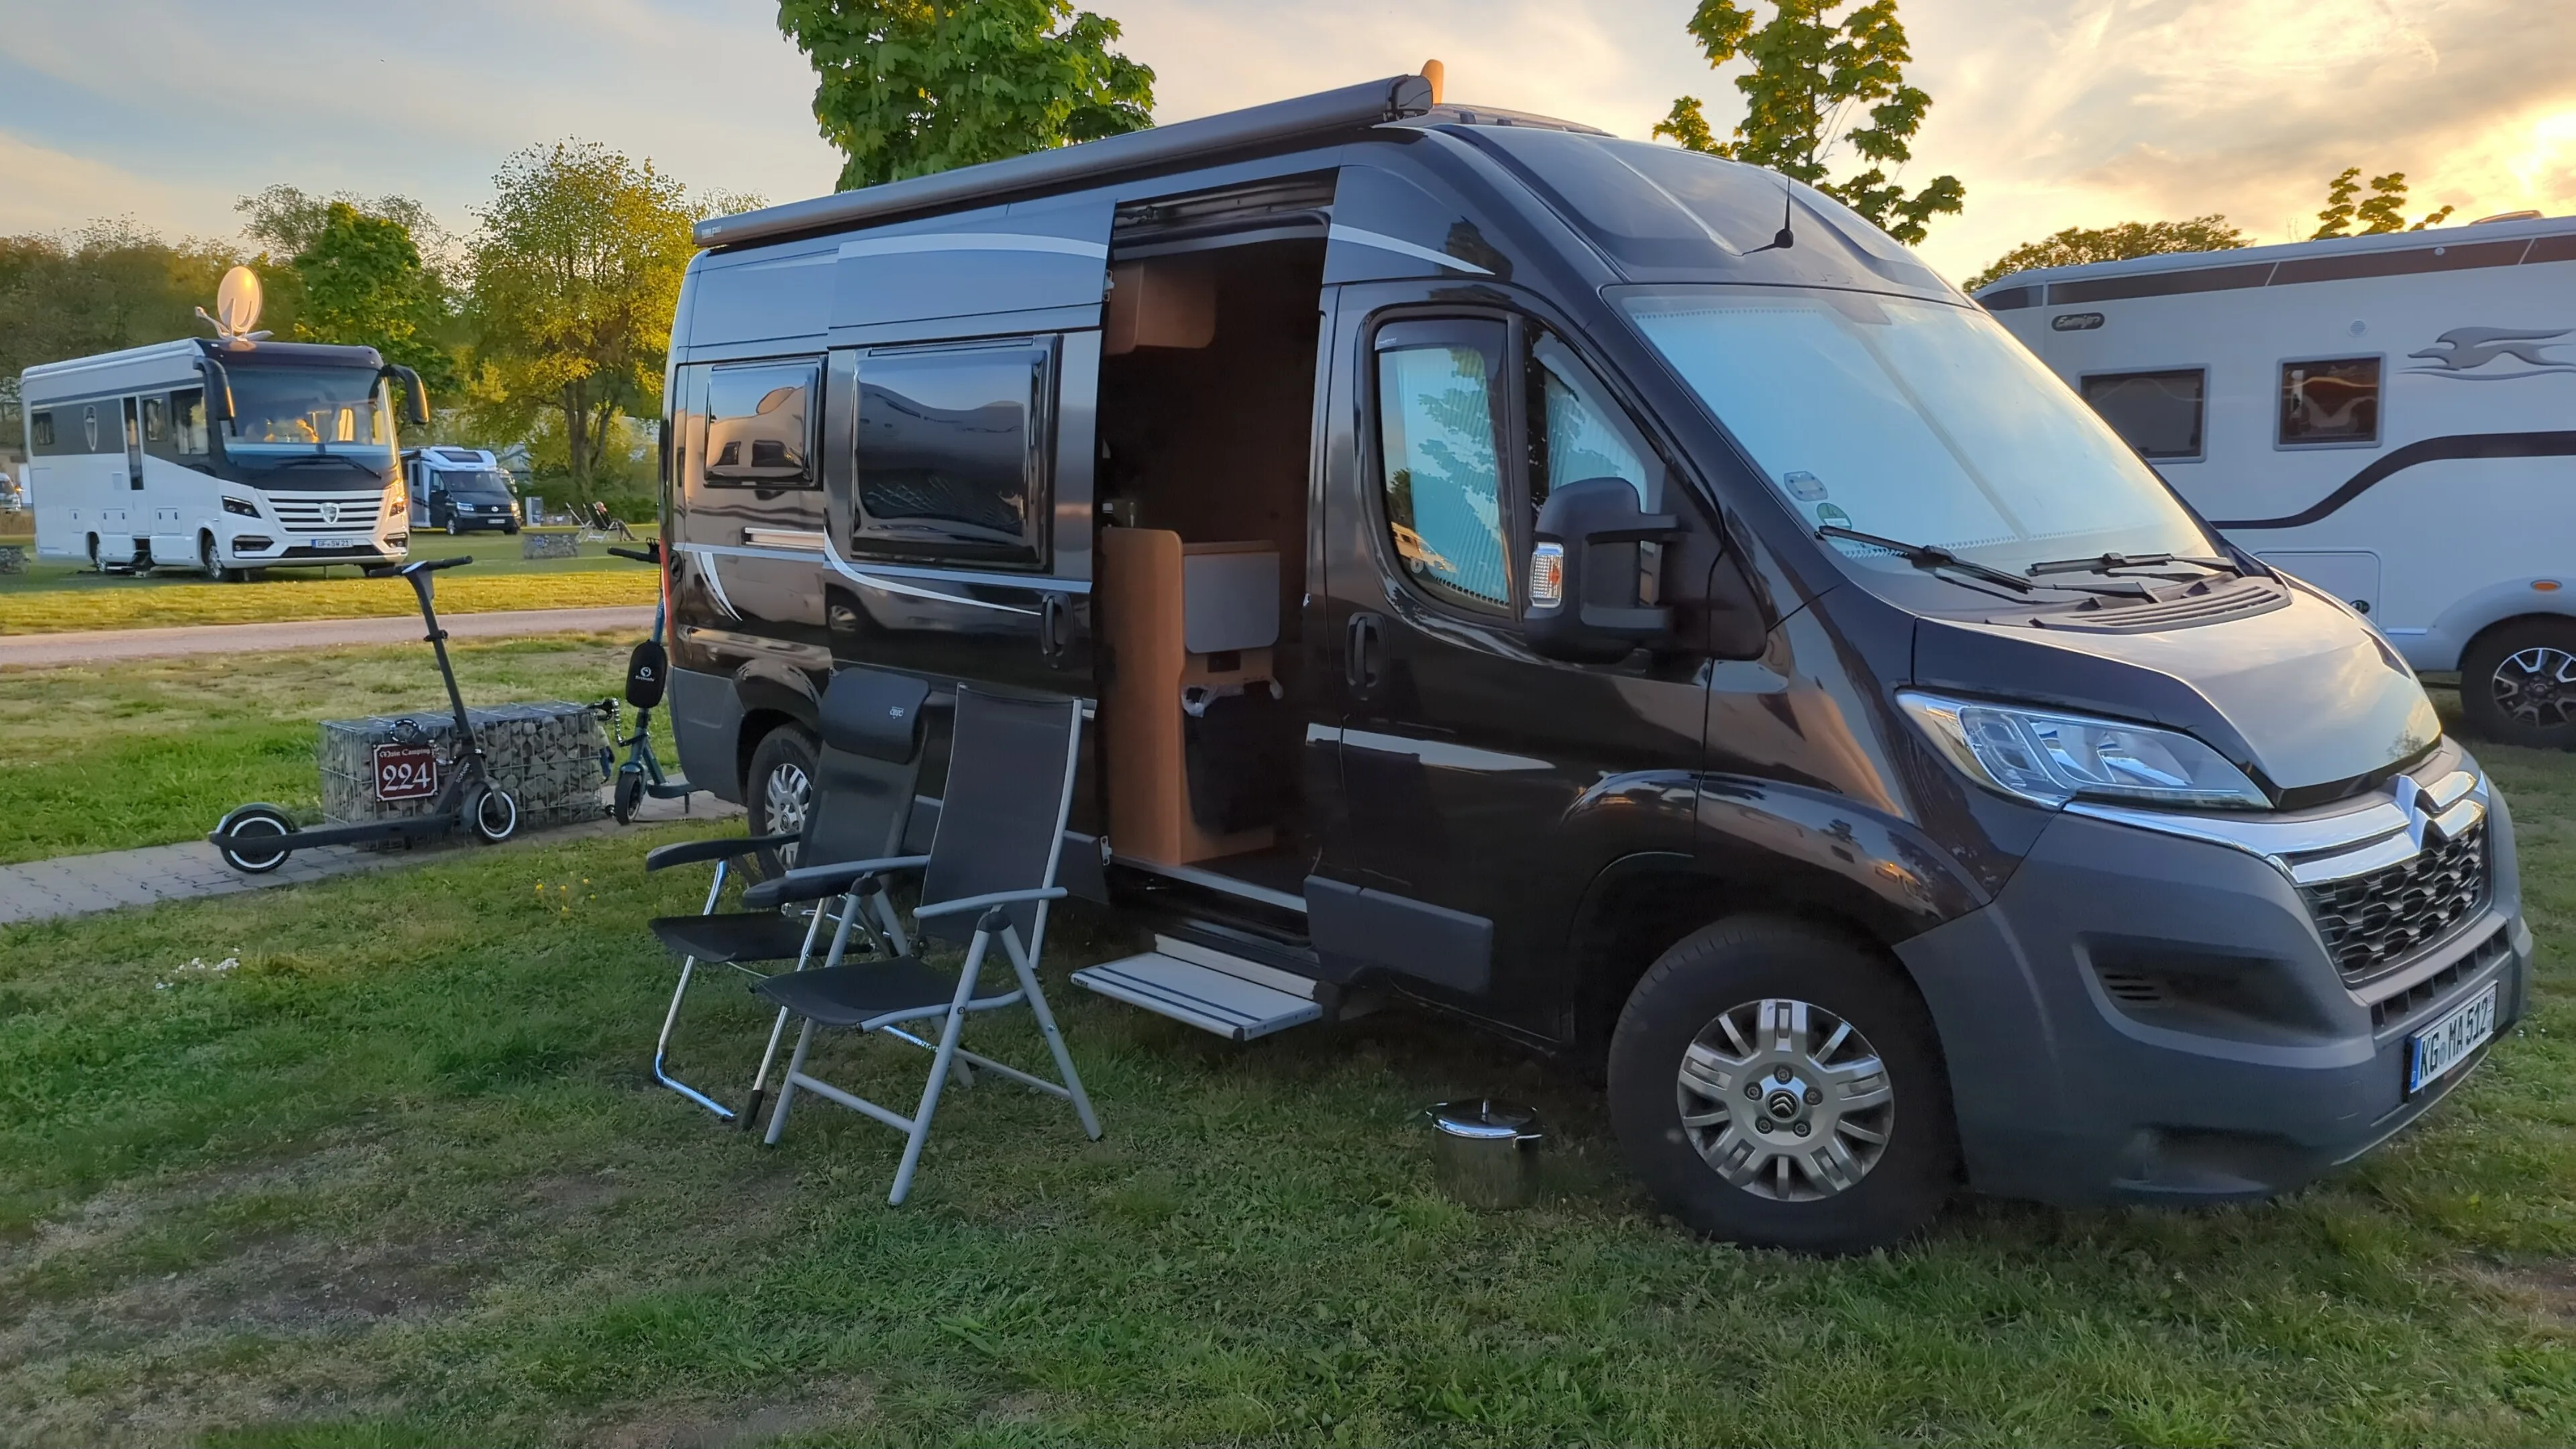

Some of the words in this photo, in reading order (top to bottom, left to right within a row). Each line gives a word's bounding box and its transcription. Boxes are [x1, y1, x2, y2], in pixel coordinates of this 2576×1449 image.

[382, 762, 431, 792] 224
[2420, 1032, 2439, 1080] KG
[2448, 1015, 2463, 1061] MA
[2466, 997, 2487, 1045] 512
